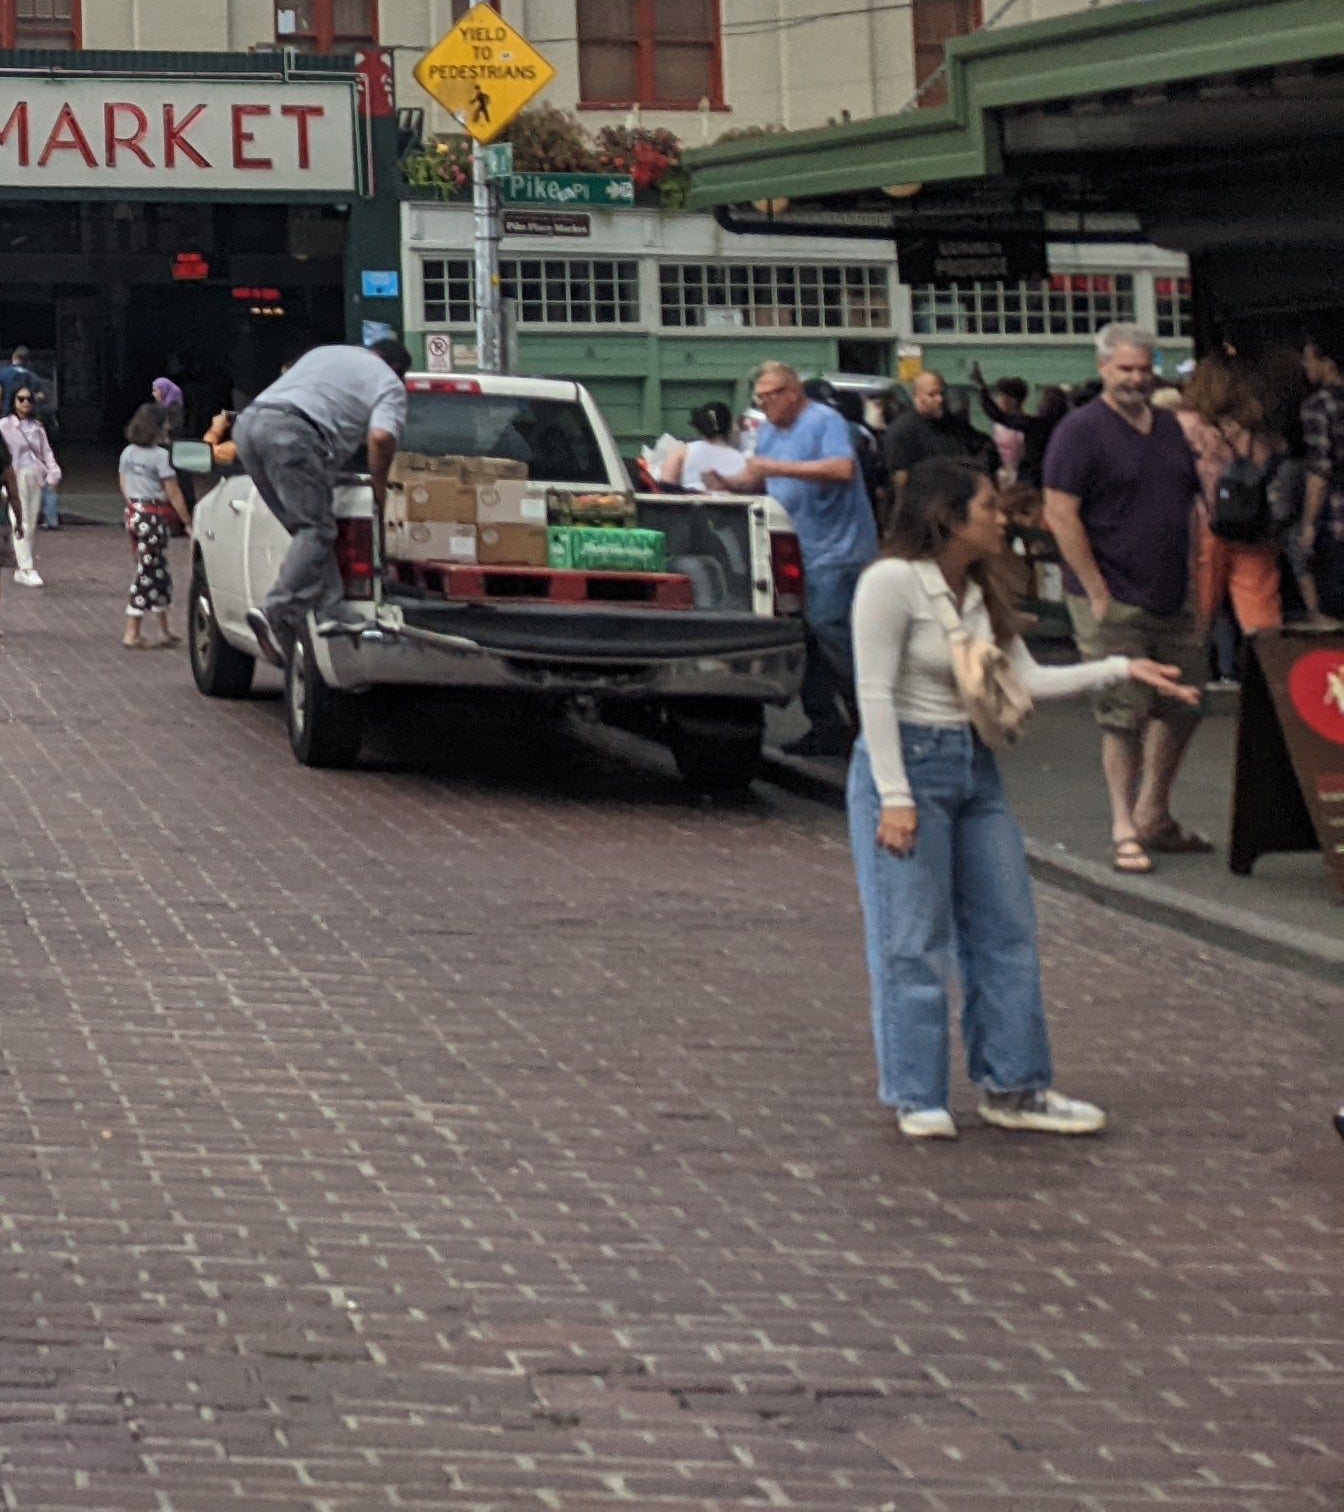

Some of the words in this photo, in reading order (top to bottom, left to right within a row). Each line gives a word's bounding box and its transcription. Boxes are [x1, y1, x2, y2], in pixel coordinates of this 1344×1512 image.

[459, 27, 507, 42] YIELD
[472, 45, 493, 61] TO
[429, 64, 537, 80] PEDESTRIANS
[510, 174, 560, 201] Pike
